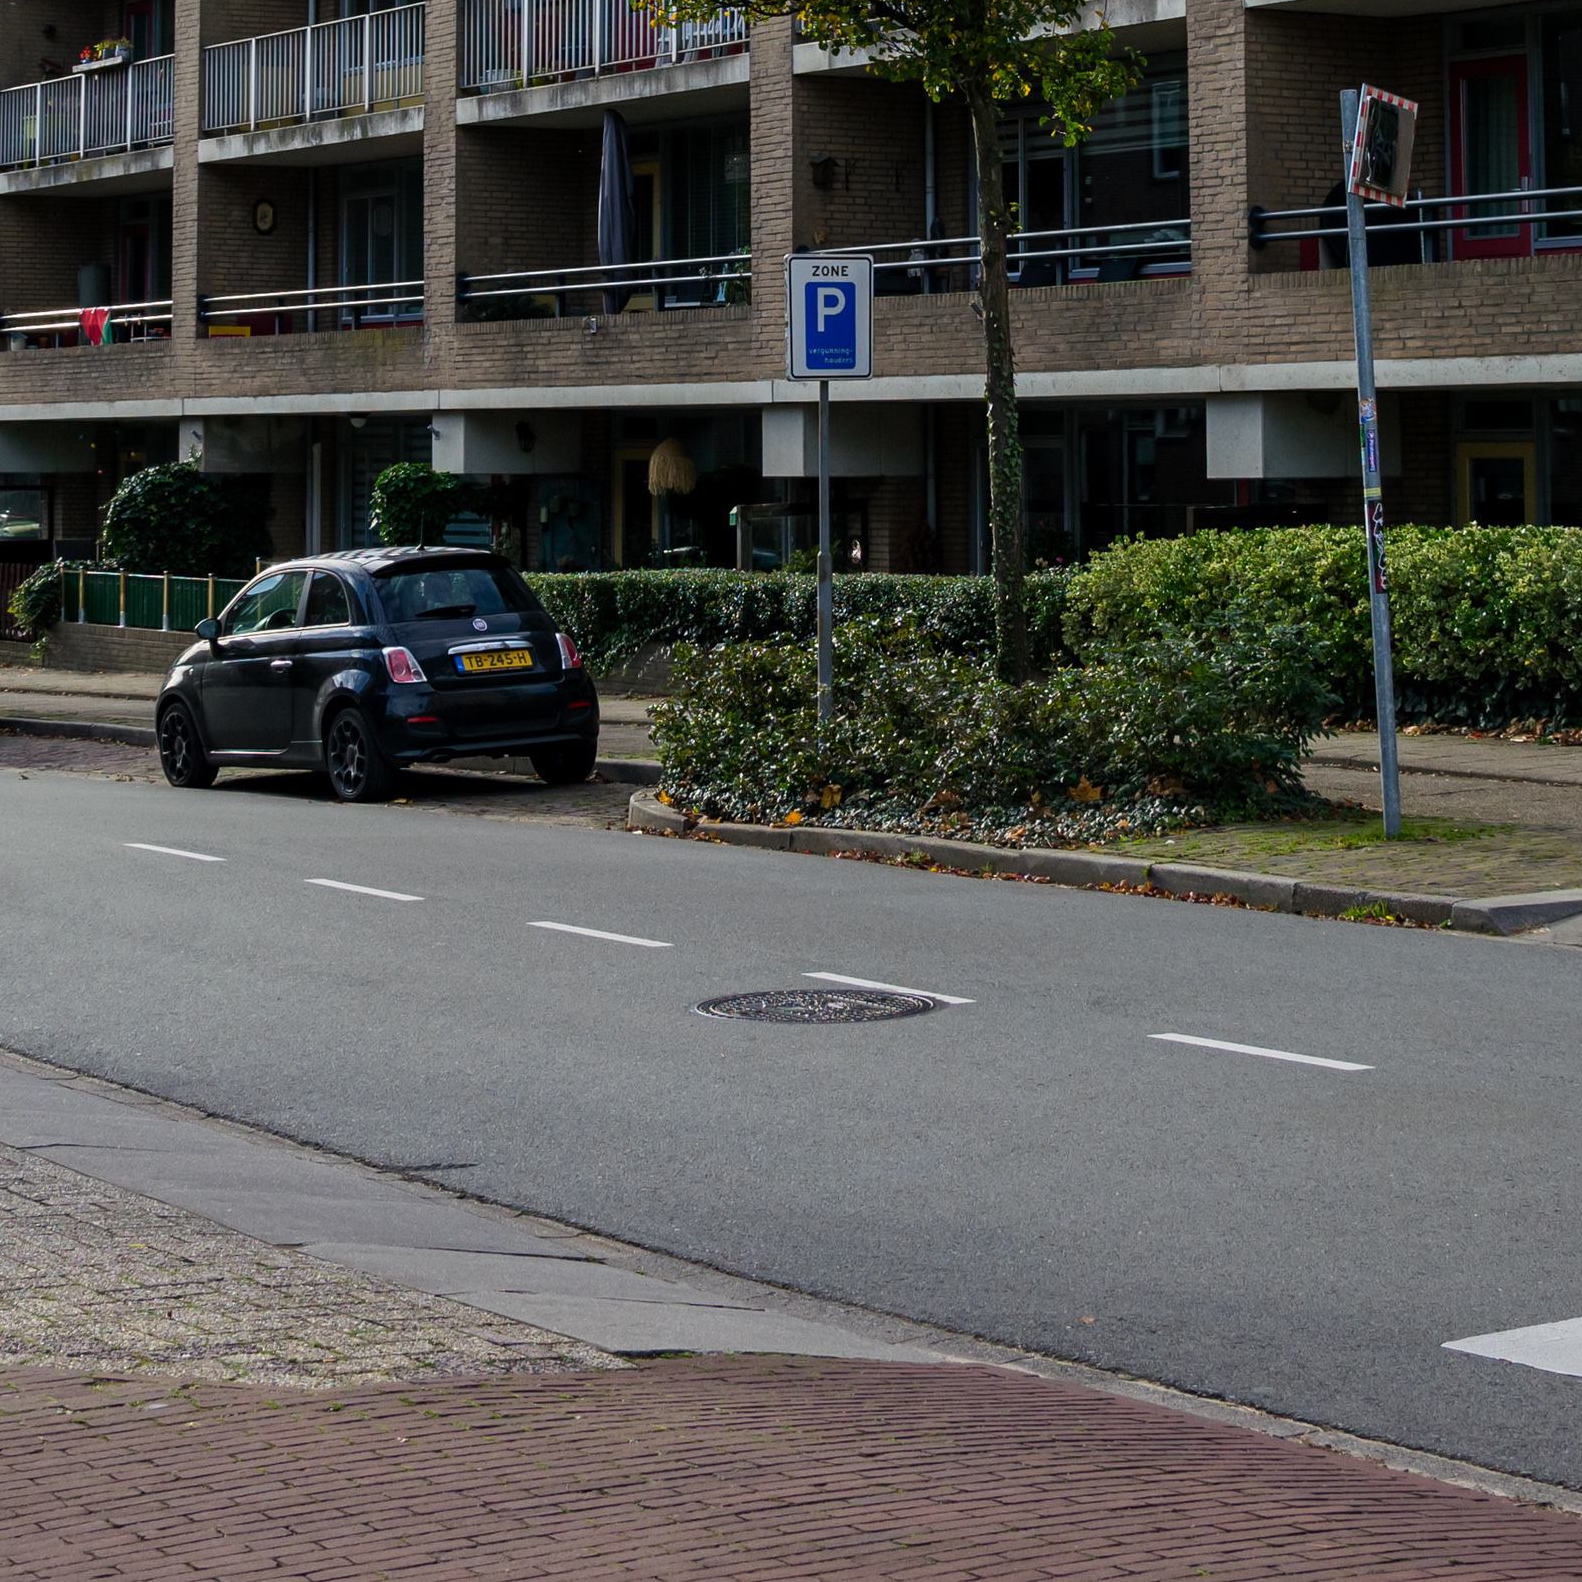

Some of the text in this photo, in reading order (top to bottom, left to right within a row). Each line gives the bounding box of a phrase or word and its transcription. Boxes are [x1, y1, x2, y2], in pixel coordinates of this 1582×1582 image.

[812, 265, 849, 277] ZONE
[817, 287, 846, 332] P
[809, 348, 853, 356] vergunning-
[466, 652, 527, 668] TB-245-H
